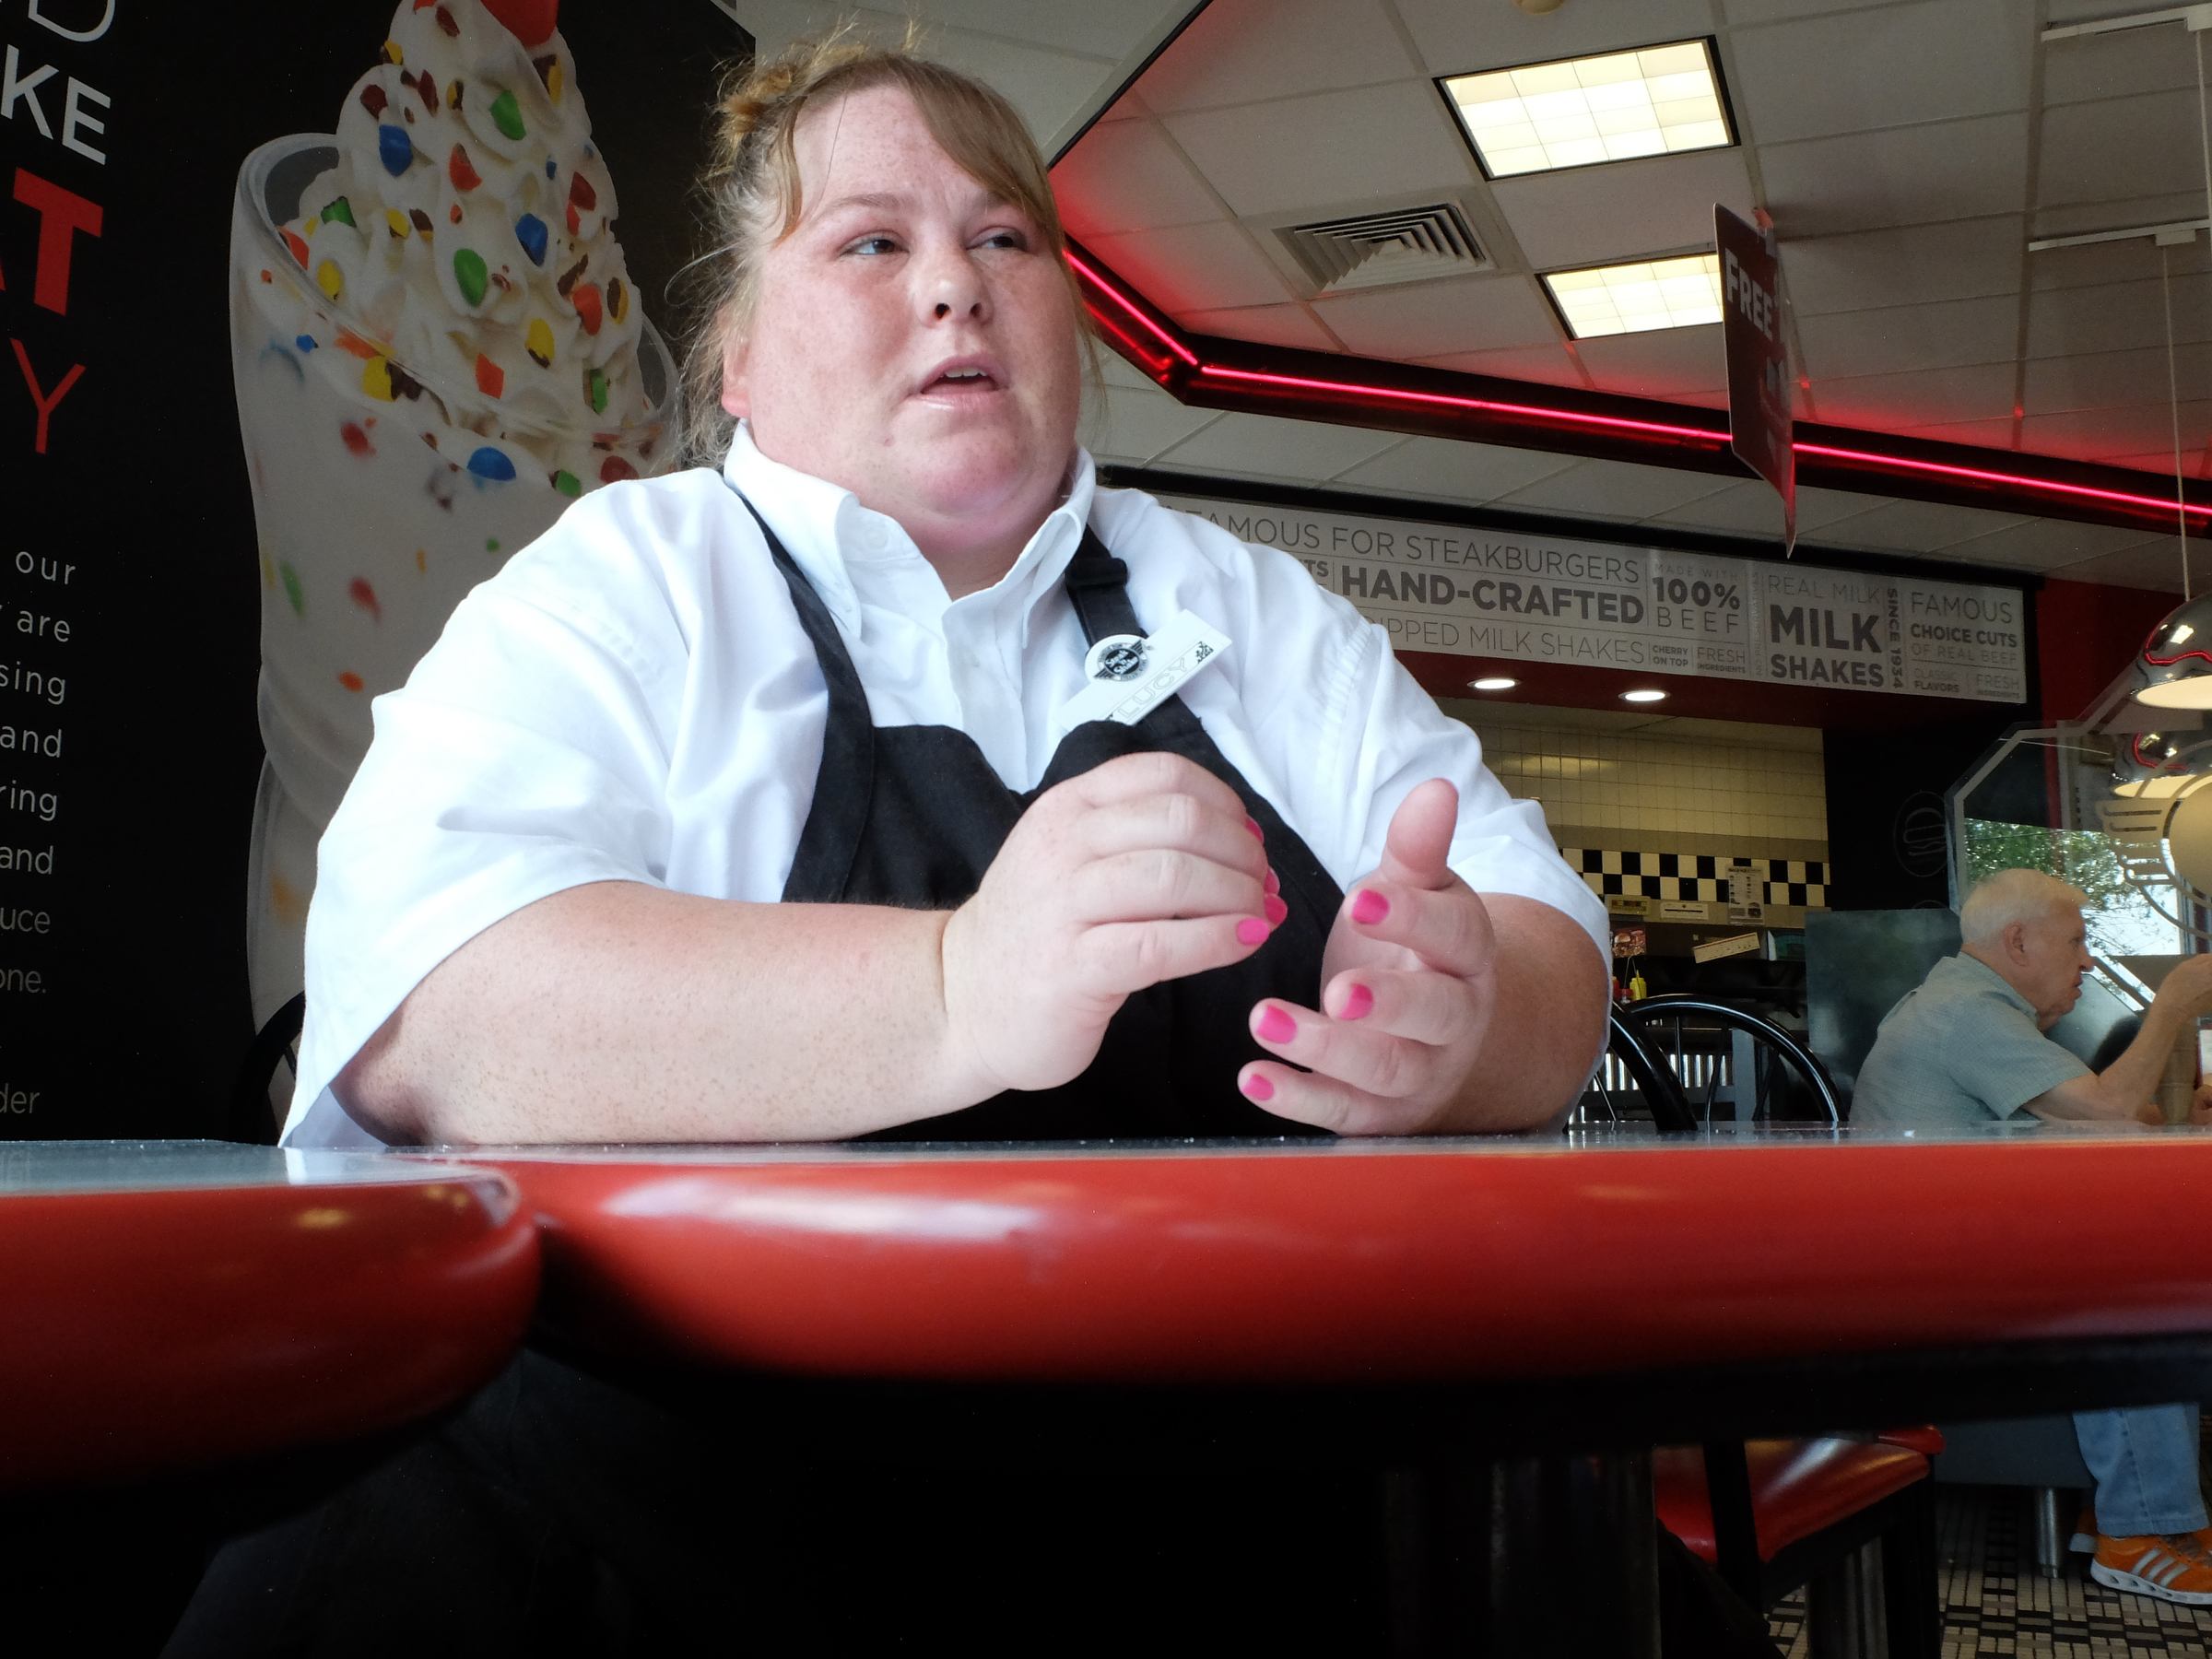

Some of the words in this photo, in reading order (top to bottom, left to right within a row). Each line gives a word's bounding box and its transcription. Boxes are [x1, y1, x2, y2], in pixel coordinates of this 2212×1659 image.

[0, 44, 111, 165] KE
[0, 167, 104, 316] T
[1724, 247, 1773, 343] FREE
[10, 336, 87, 454] Y
[16, 551, 76, 585] our
[1333, 526, 1394, 557] FOR
[1406, 535, 1639, 583] STEAKBURGERS
[1655, 563, 1694, 577] MADE
[1702, 569, 1738, 581] WITH
[1298, 559, 1329, 578] TS
[1342, 565, 1644, 624] HAND-CRAFTED
[1652, 576, 1740, 610] 100%
[1769, 575, 1824, 599] REAL
[1833, 583, 1881, 605] MILK
[1657, 606, 1738, 633] BEEF
[1887, 588, 1900, 642] SINCE
[1911, 592, 2013, 624] FAMOUS
[17, 610, 70, 642] are
[1364, 616, 1460, 646] PPED
[1470, 626, 1532, 653] MILK
[1541, 632, 1644, 665] SHAKES
[1770, 605, 1882, 653] MILK
[1911, 623, 1972, 643] CHOICE
[1976, 630, 2018, 648] CUTS
[1653, 645, 1688, 655] CHERRY
[1653, 656, 1667, 665] ON
[1670, 657, 1688, 666] TOP
[1697, 647, 1746, 664] FRESH
[1912, 643, 1930, 656] OF
[1937, 645, 1974, 661] REAL
[1981, 650, 2017, 664] BEEF
[0, 661, 65, 704] sing
[1697, 664, 1747, 674] INGREDIENTS
[1771, 653, 1884, 688] SHAKES
[1890, 647, 1904, 689] 1934
[1118, 657, 1188, 719] LUCY
[1914, 680, 1960, 692] FLAVORS
[0, 725, 62, 758] and
[0, 844, 53, 875] and
